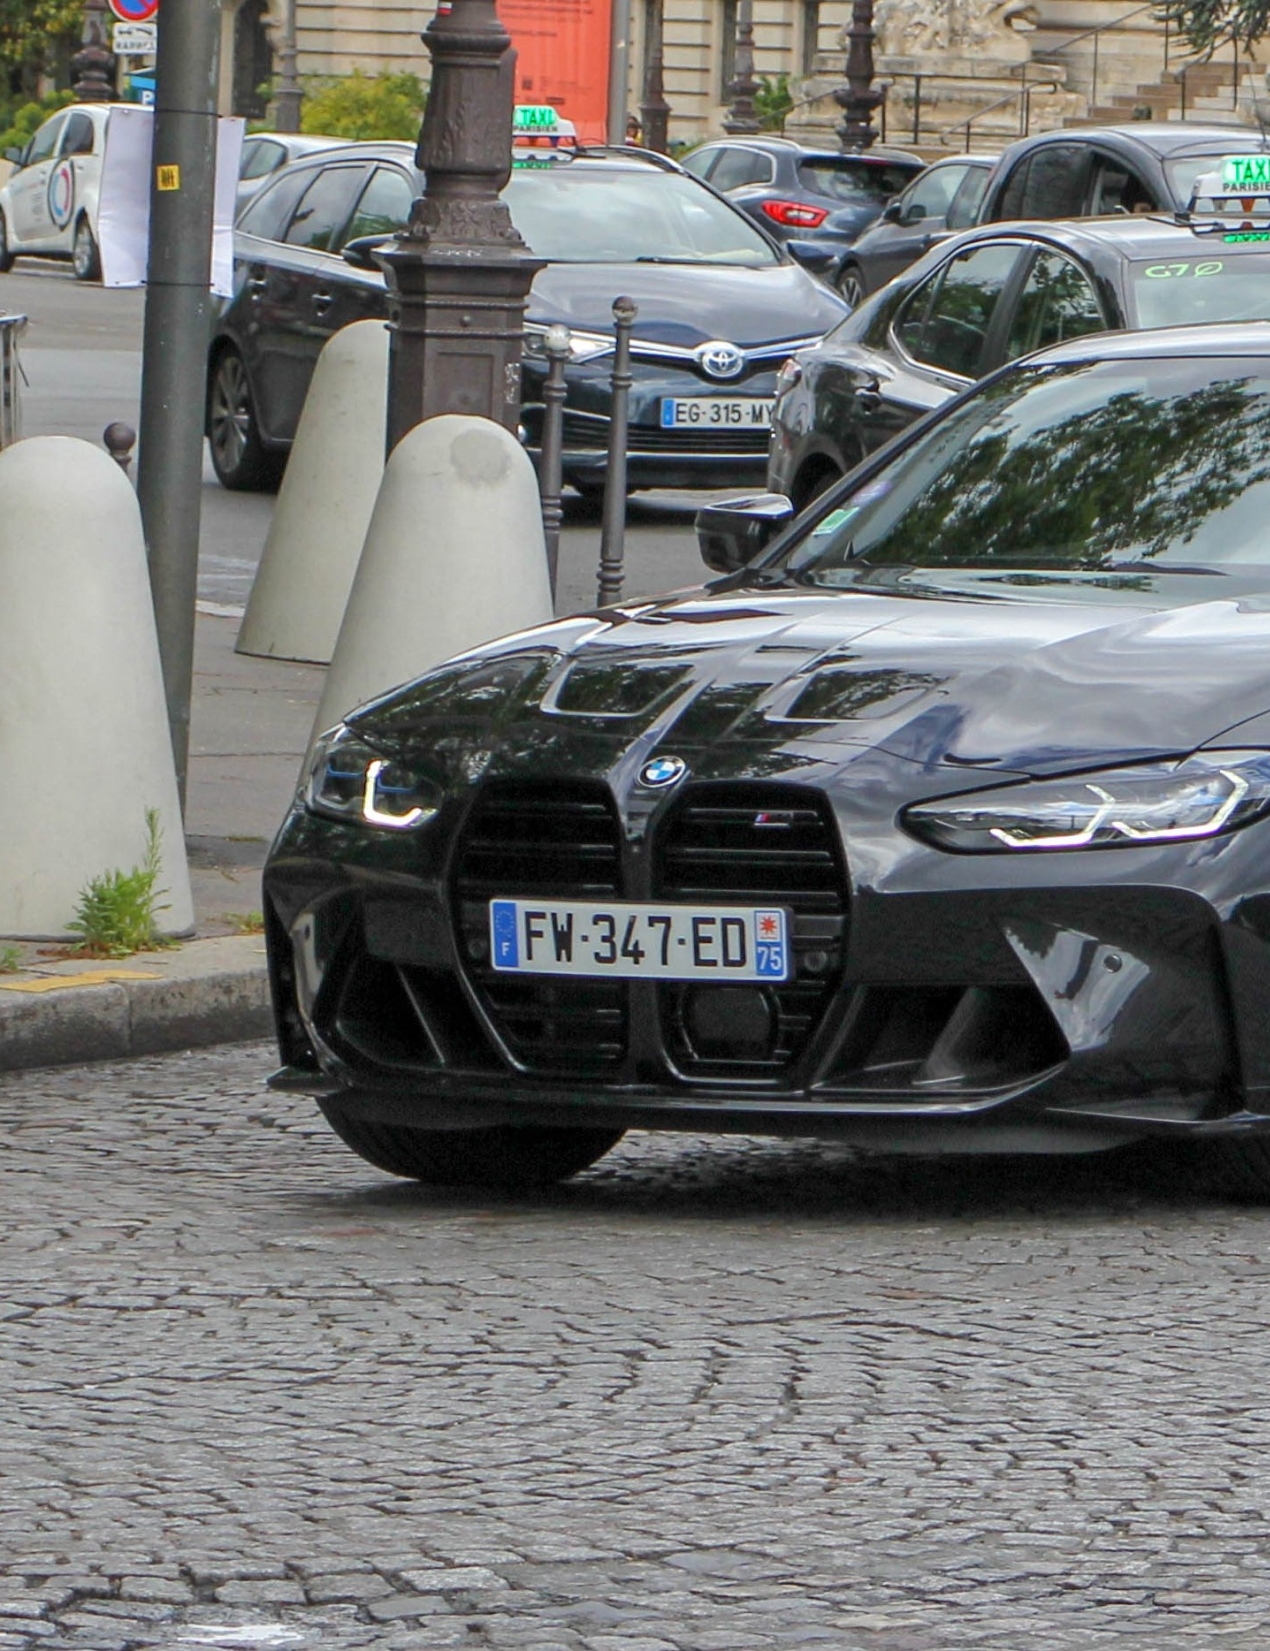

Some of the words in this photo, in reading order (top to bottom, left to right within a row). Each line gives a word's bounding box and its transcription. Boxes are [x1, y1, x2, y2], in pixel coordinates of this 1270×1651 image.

[520, 109, 553, 125] TAXI
[513, 125, 558, 133] PARISIEN
[524, 911, 747, 968] FW-347-ED
[502, 942, 510, 956] F
[757, 946, 782, 971] 75
